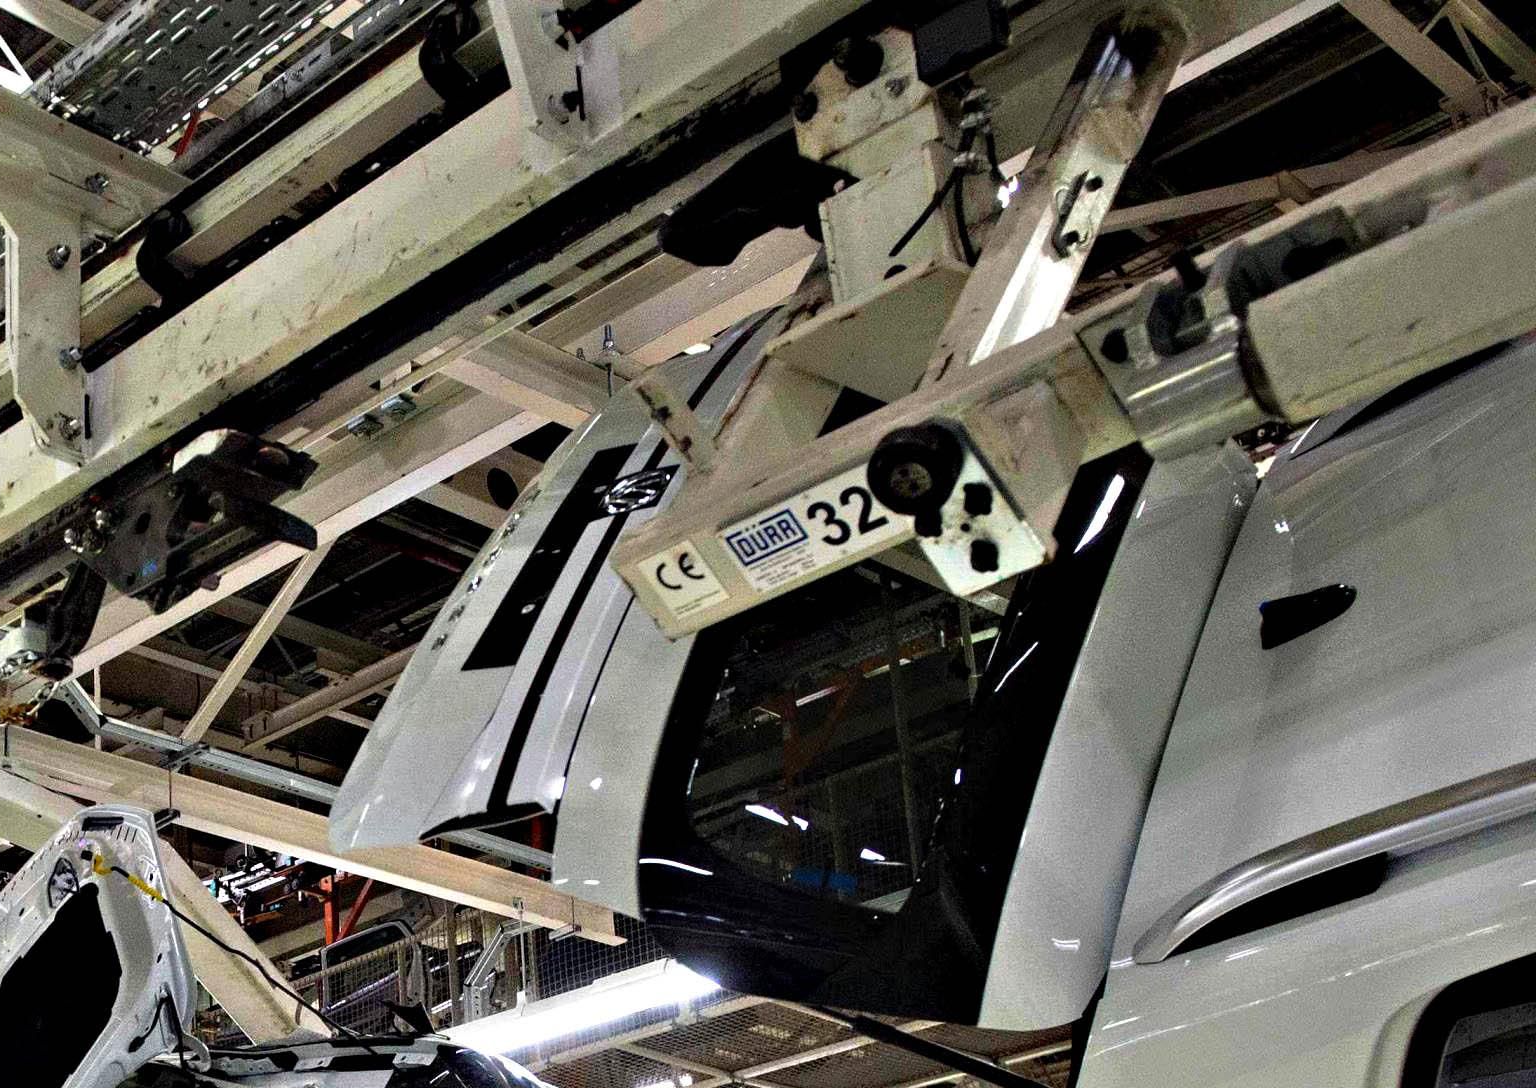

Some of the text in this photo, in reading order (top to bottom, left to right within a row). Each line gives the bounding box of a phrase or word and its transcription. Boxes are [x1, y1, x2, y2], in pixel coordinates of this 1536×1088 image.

[734, 486, 889, 559] DÜRR 32
[656, 552, 705, 590] CE
